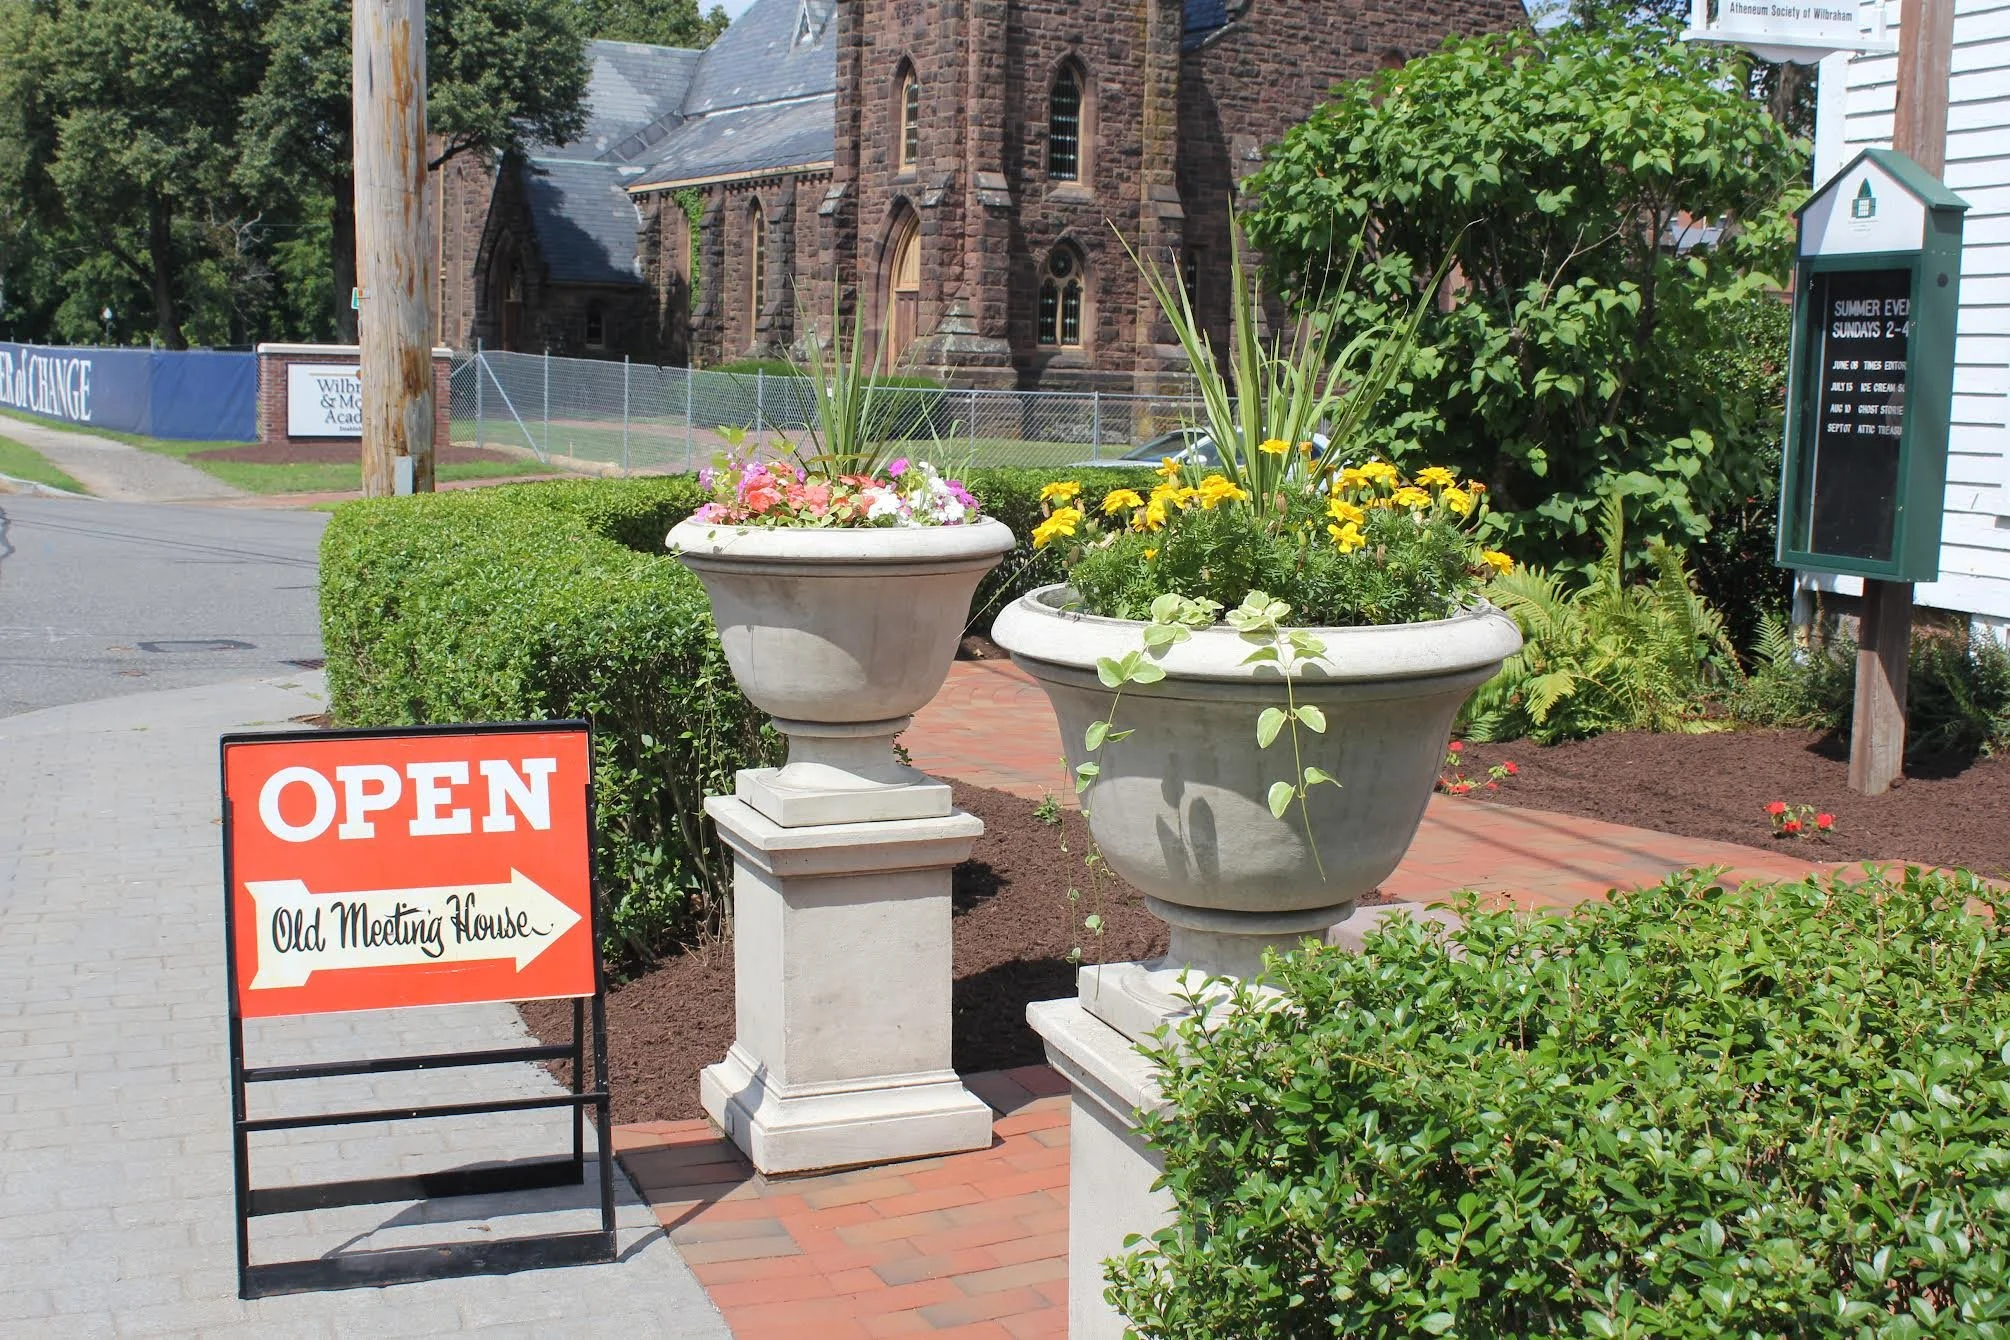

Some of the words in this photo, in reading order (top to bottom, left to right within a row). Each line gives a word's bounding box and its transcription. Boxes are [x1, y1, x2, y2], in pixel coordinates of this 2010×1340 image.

[1729, 2, 1769, 16] Atheneum
[1771, 4, 1800, 20] Society
[1803, 8, 1811, 19] of
[1814, 7, 1853, 22] Wilbraham
[1834, 300, 1880, 317] SUMMER
[1832, 321, 1881, 338] SUNDAYS
[1886, 321, 1910, 338] 2-4
[1832, 360, 1850, 370] JUNE
[0, 351, 14, 405] ER
[15, 348, 28, 407] of
[28, 354, 92, 421] CHANGE
[316, 378, 362, 394] Wilbr
[1830, 382, 1846, 392] JULY
[1860, 382, 1872, 393] ICE
[1873, 382, 1896, 393] CREAM
[320, 394, 336, 409] &
[339, 394, 362, 409] Mo
[324, 408, 362, 424] Acad
[1880, 405, 1904, 416] STORIE
[1827, 423, 1843, 433] SEPT
[1857, 424, 1875, 434] ATTIC
[1878, 425, 1902, 436] TREASU
[258, 757, 557, 843] OPEN
[271, 905, 326, 954] Old
[330, 899, 445, 959] Meeting
[446, 892, 553, 945] House
